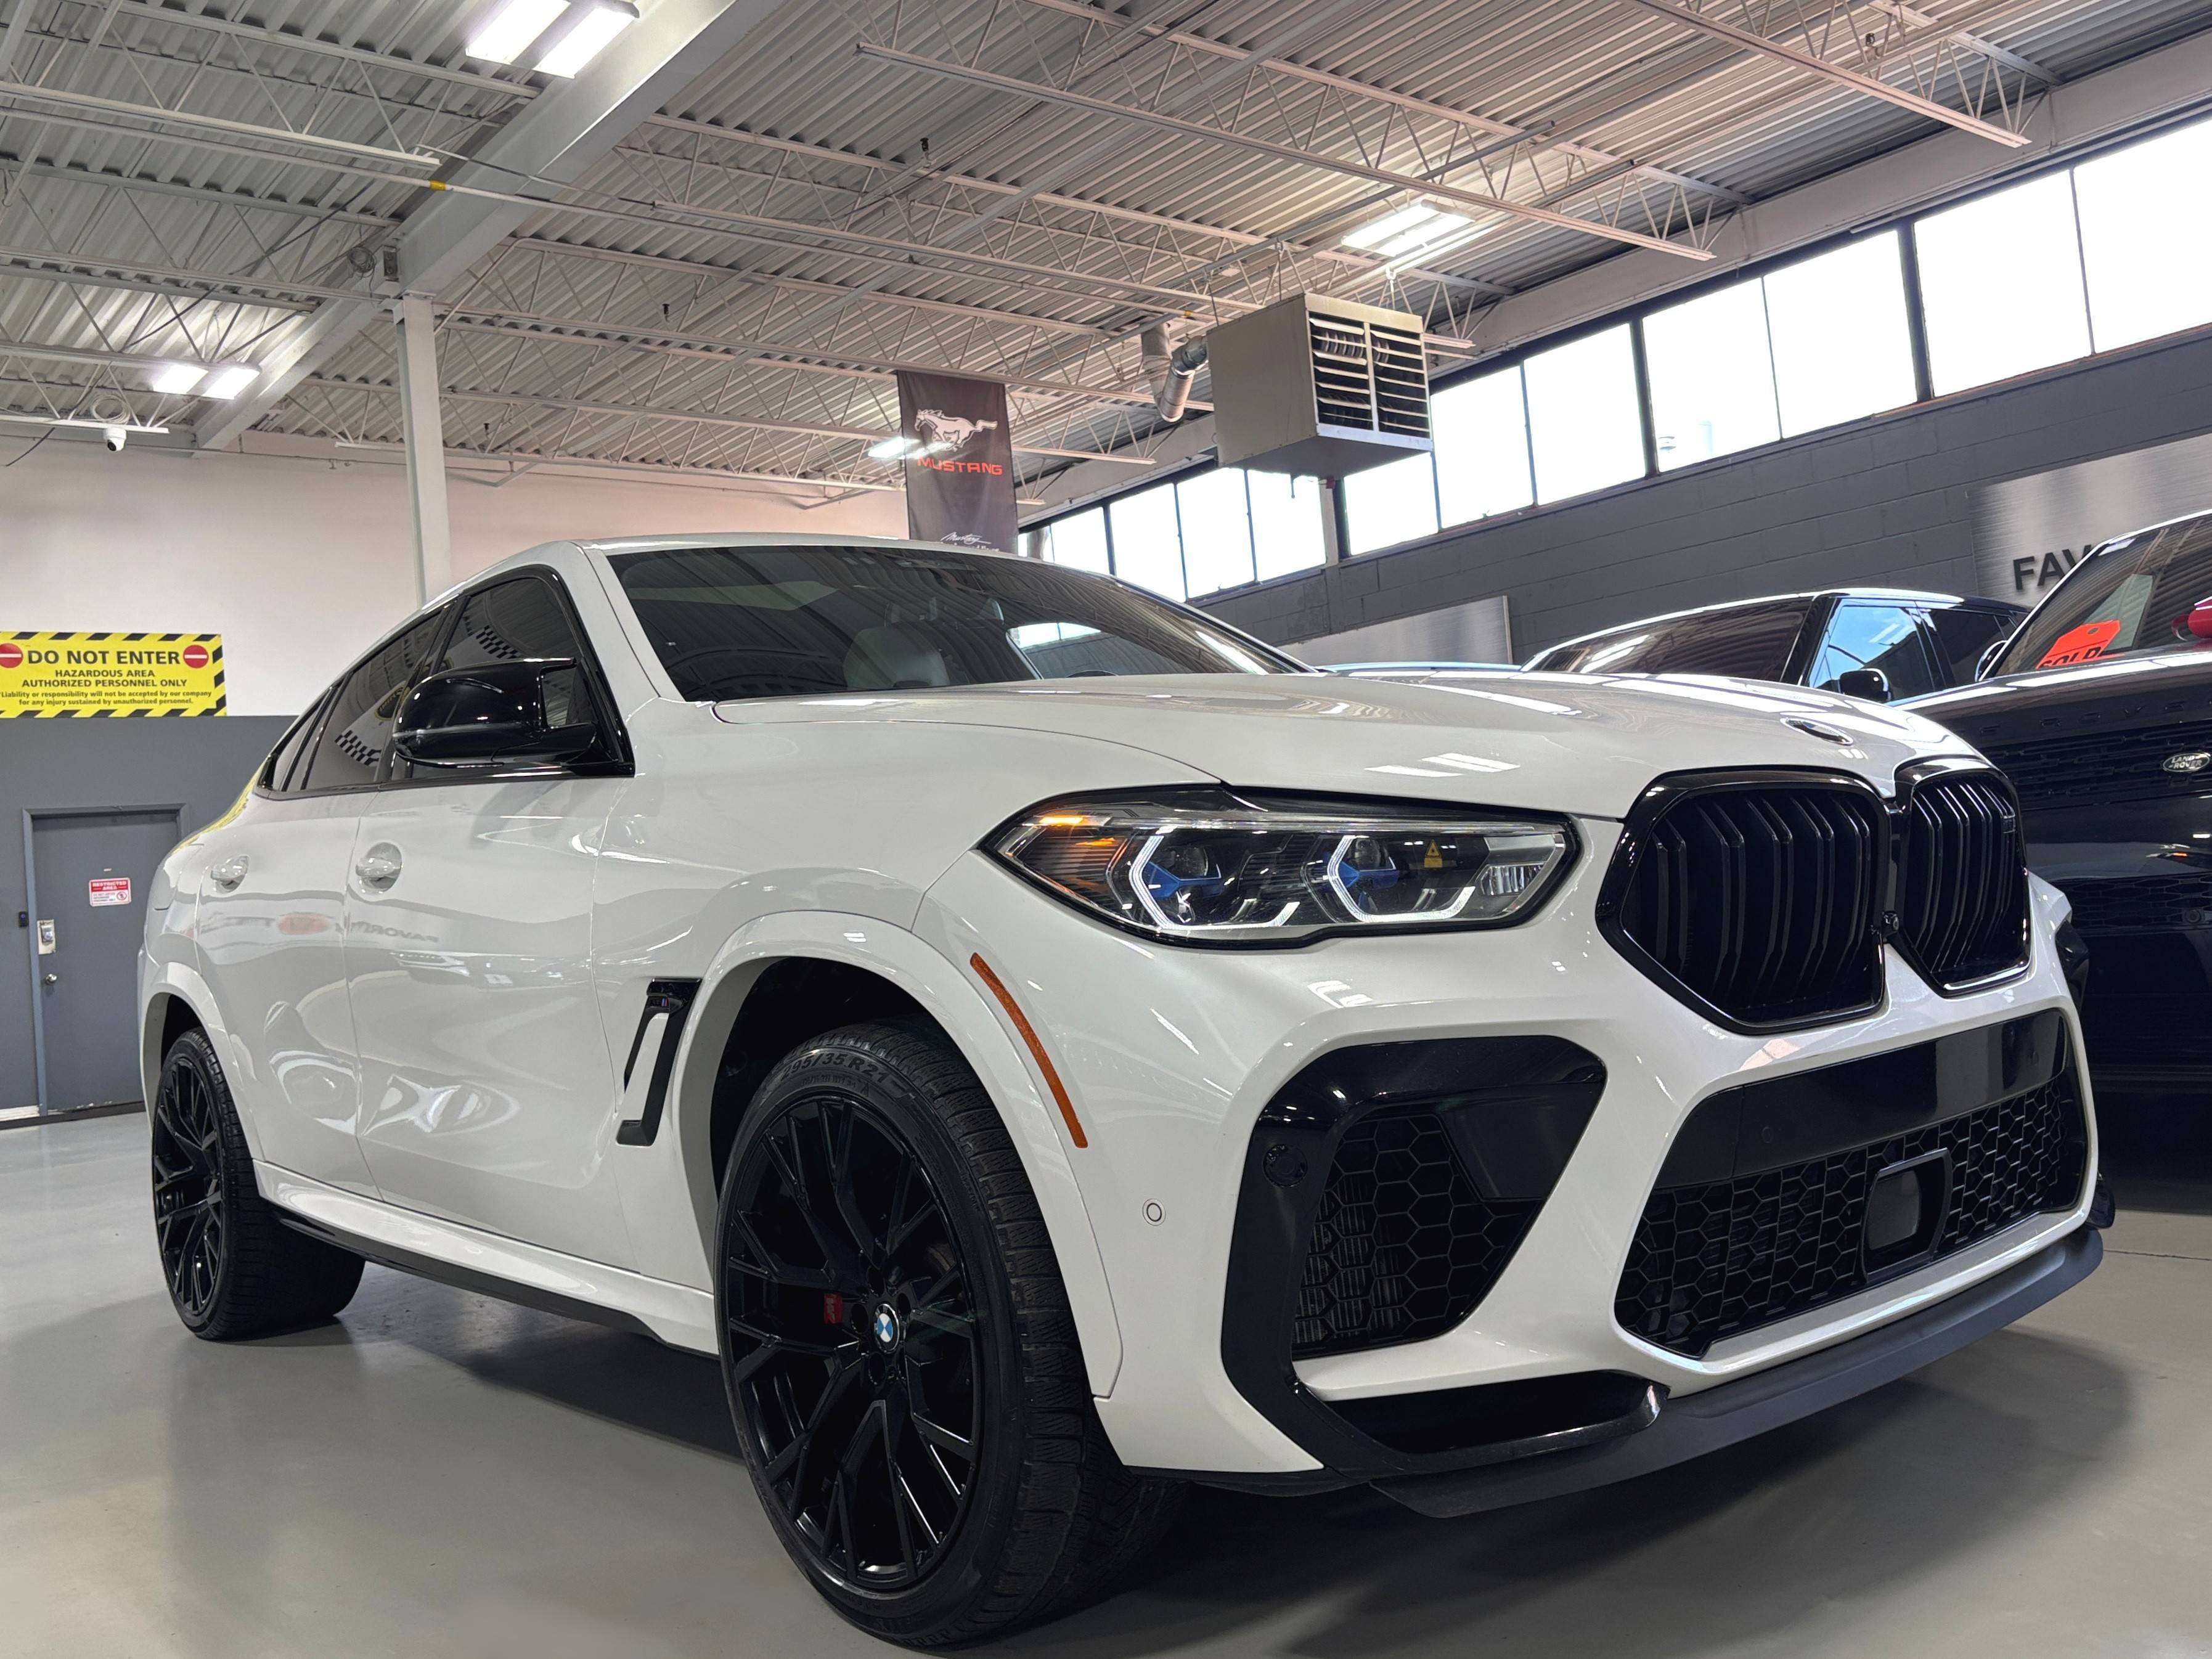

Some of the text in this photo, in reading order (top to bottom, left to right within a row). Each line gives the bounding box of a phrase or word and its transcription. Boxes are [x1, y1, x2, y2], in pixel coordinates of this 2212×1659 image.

[917, 457, 1002, 475] MUSTANG
[28, 650, 180, 665] DO NOT ENTER
[55, 669, 123, 677] HAZARDOUS
[22, 679, 187, 687] AUTHORIZED PERSONNEL ONLY
[41, 690, 88, 698] responsibility
[102, 698, 111, 706] by
[2171, 756, 2195, 764] LAND
[2173, 760, 2203, 769] ROVER
